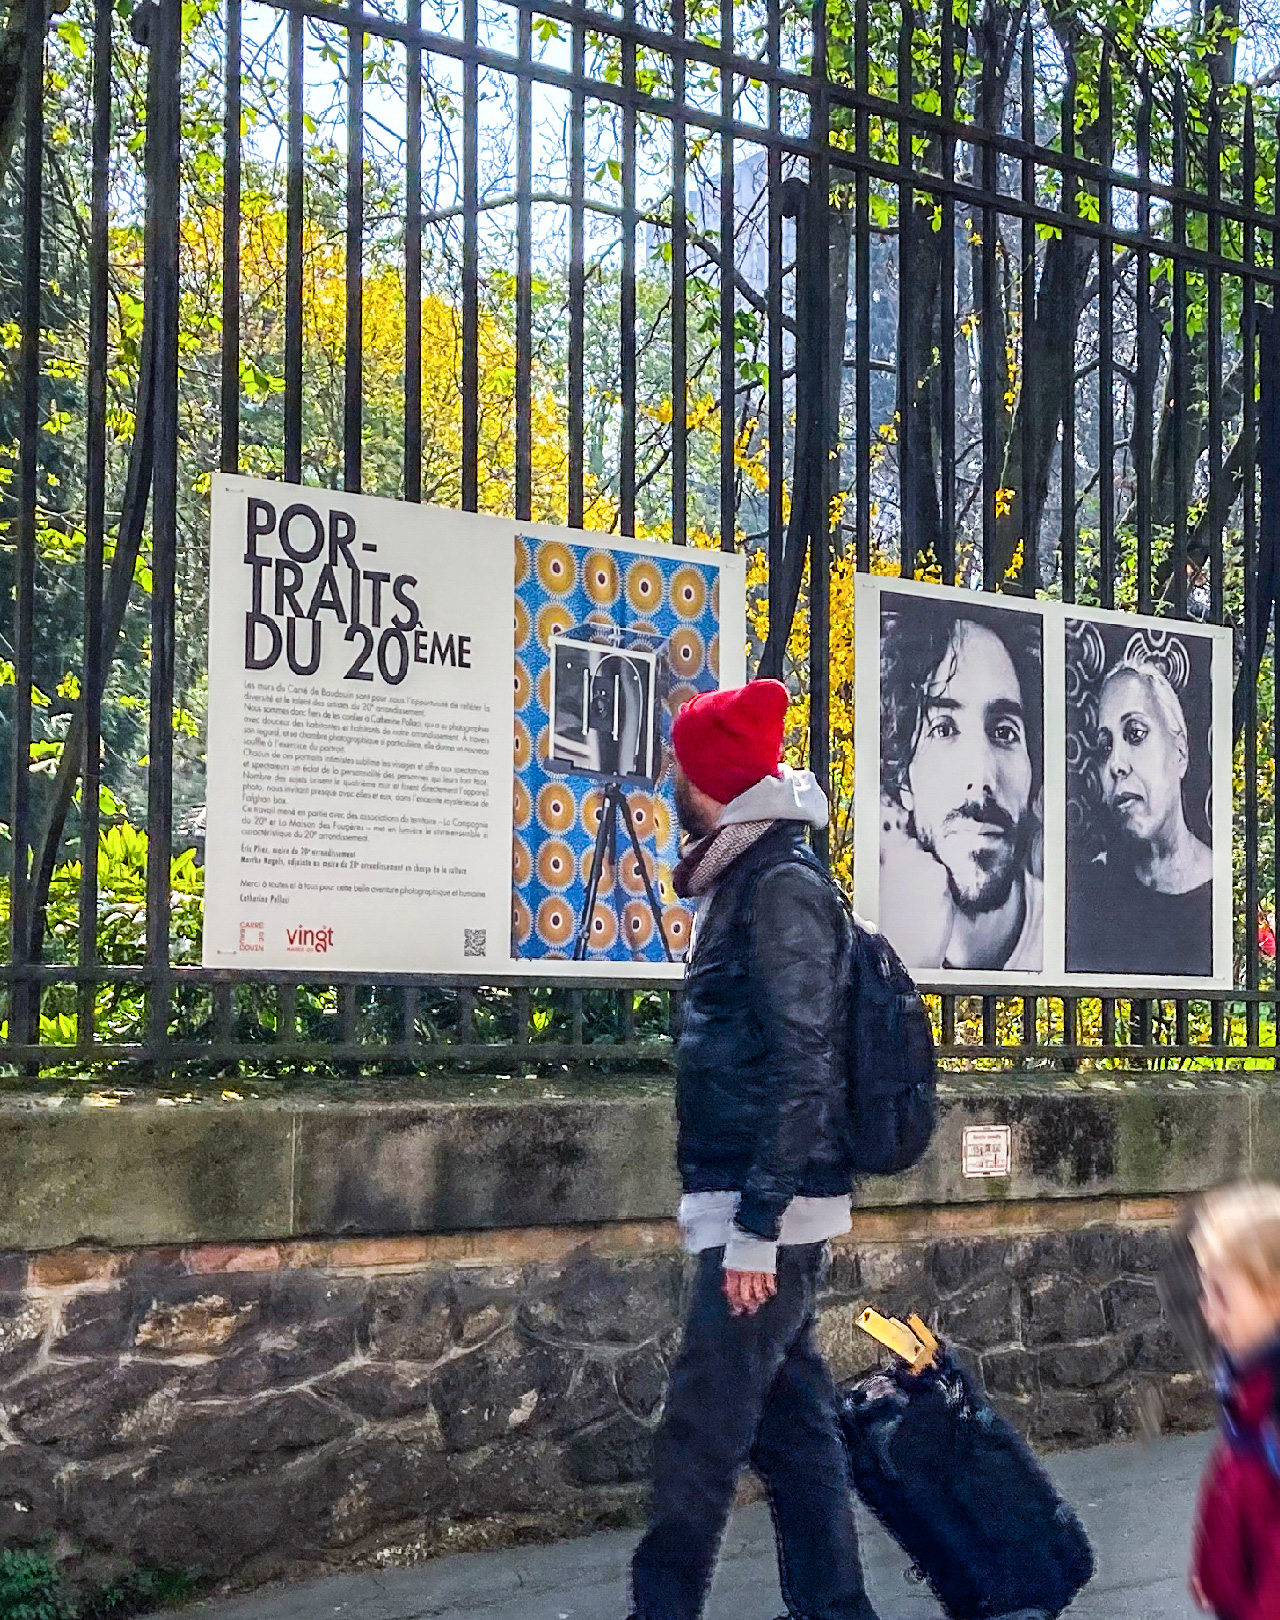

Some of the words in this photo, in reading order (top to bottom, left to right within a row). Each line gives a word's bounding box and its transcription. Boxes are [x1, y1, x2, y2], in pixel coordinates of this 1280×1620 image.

[246, 497, 377, 569] POR-
[244, 553, 420, 632] TRAITS
[245, 611, 322, 676] DU
